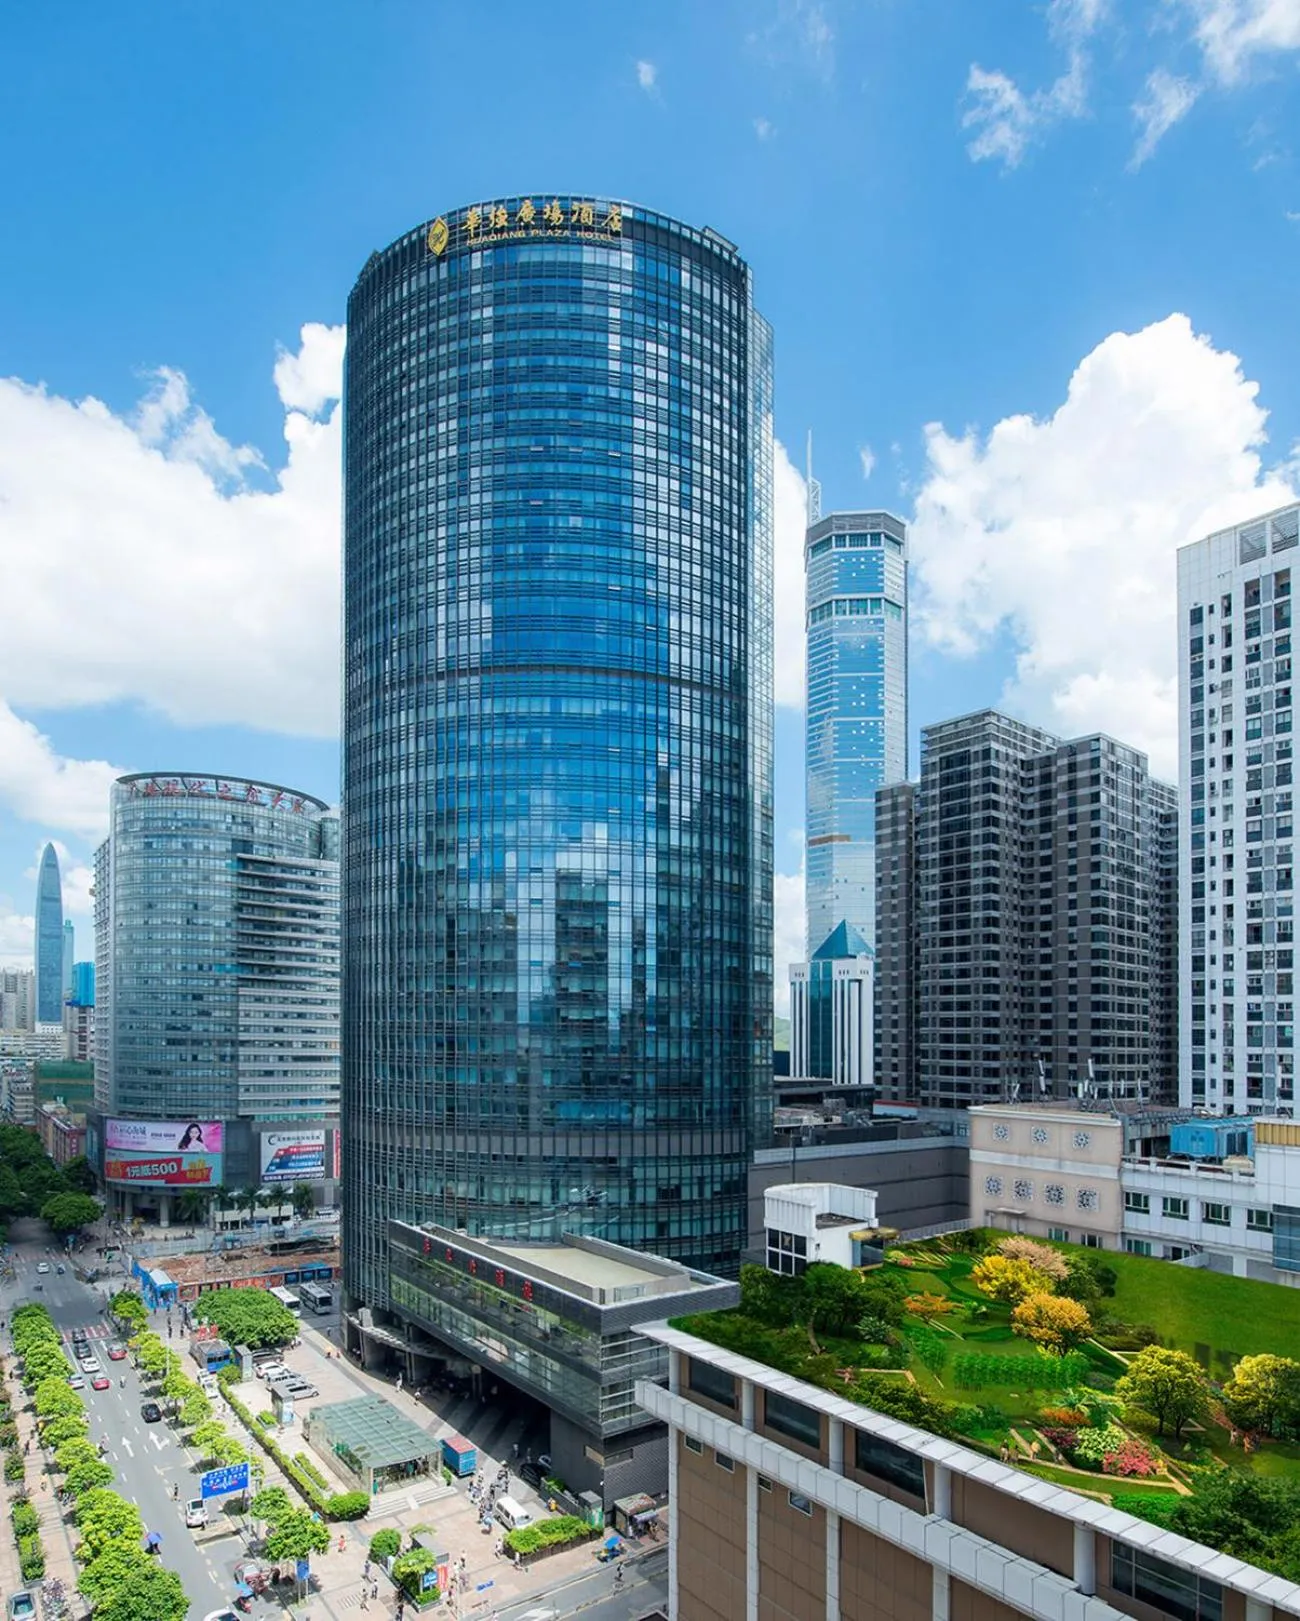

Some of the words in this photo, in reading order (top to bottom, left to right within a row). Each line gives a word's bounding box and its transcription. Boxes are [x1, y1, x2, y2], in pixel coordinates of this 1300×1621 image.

[466, 230, 526, 246] HUAQIANG
[531, 229, 571, 238] PLAZA
[576, 231, 615, 242] HOTEL
